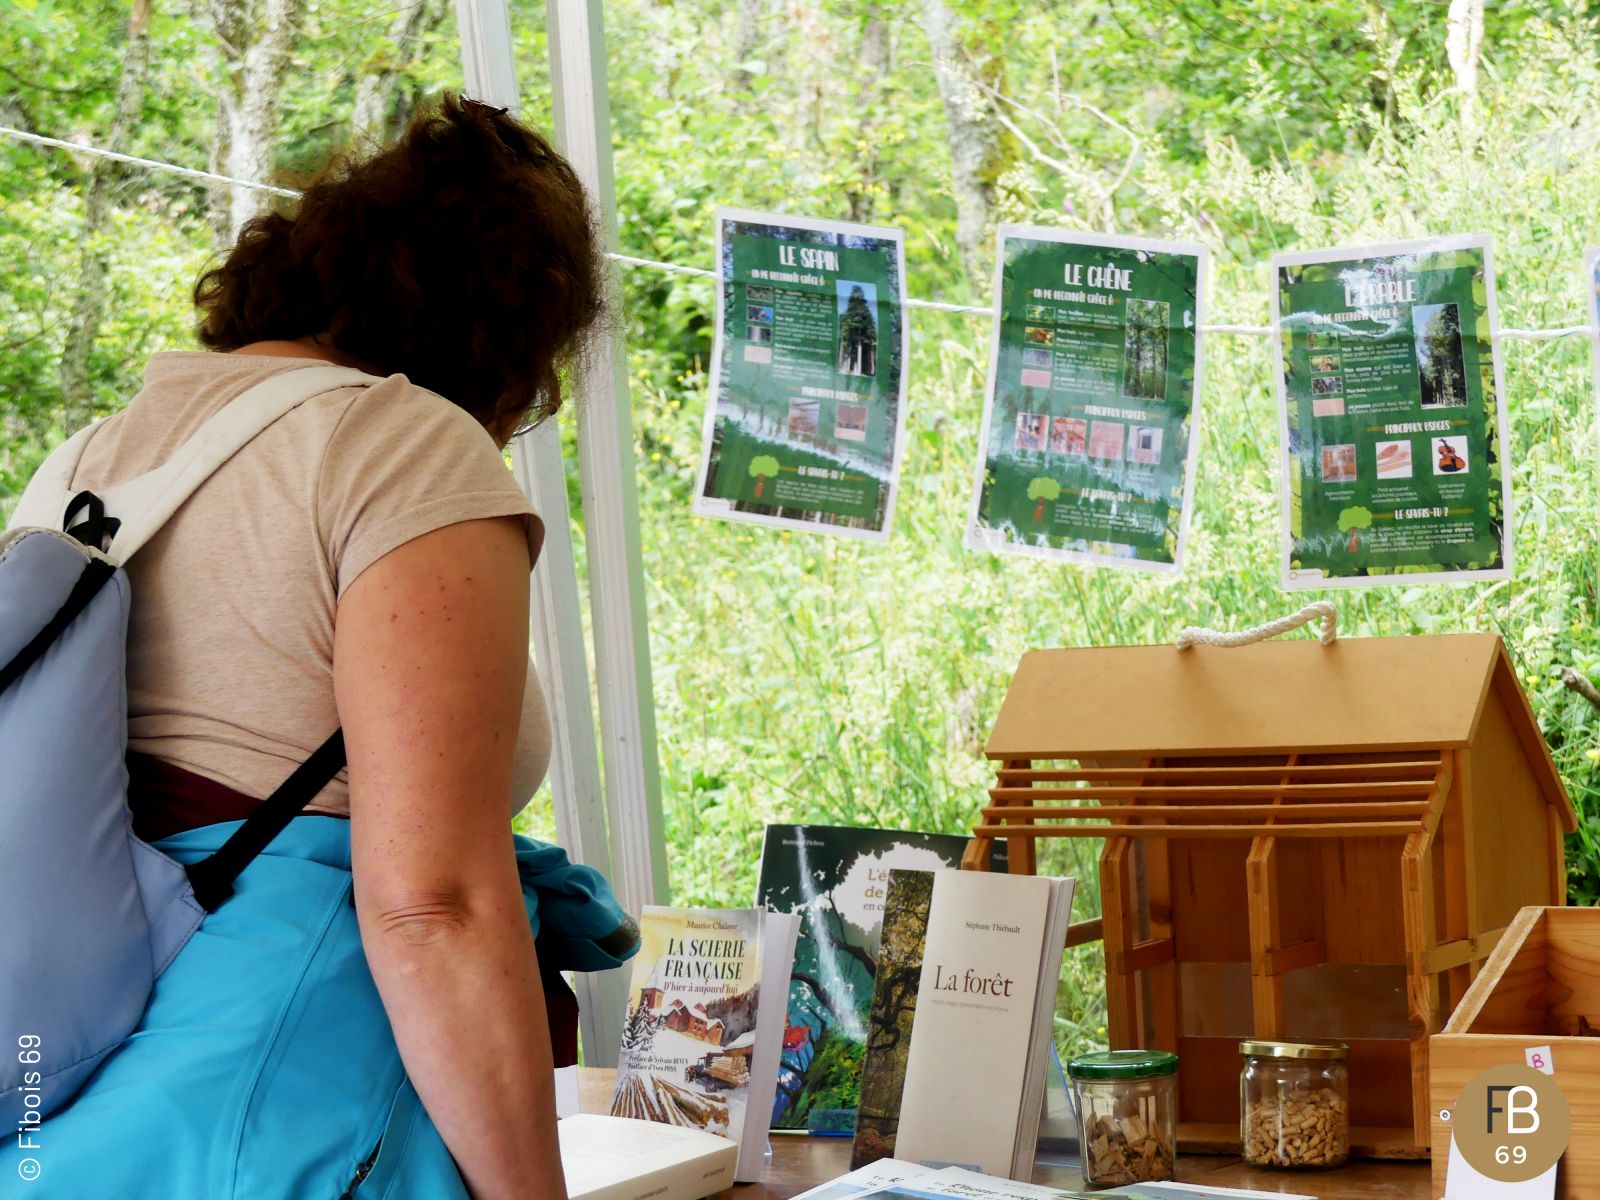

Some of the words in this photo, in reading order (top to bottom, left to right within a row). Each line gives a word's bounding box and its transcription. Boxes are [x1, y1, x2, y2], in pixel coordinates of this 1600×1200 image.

[779, 245, 797, 266] LE
[800, 247, 839, 271] SAPIN
[1064, 263, 1083, 286] LE
[1087, 262, 1134, 291] CHÊNE
[1385, 422, 1424, 434] PRINCIPAUX
[1425, 420, 1450, 431] USAGES
[1394, 510, 1404, 520] LE
[1405, 507, 1442, 519] SAVAIS-TU
[1443, 506, 1449, 517] ?
[864, 886, 884, 898] de
[863, 903, 874, 911] en
[686, 920, 711, 929] Maurice
[668, 938, 684, 956] LA
[689, 939, 746, 958] SCIERIE
[664, 959, 743, 984] FRANÇAISE
[664, 981, 686, 992] D'hier
[688, 982, 693, 992] à
[694, 983, 738, 995] aujourd'hui
[934, 965, 957, 991] La
[963, 968, 1014, 997] forêt
[1531, 1053, 1545, 1069] B
